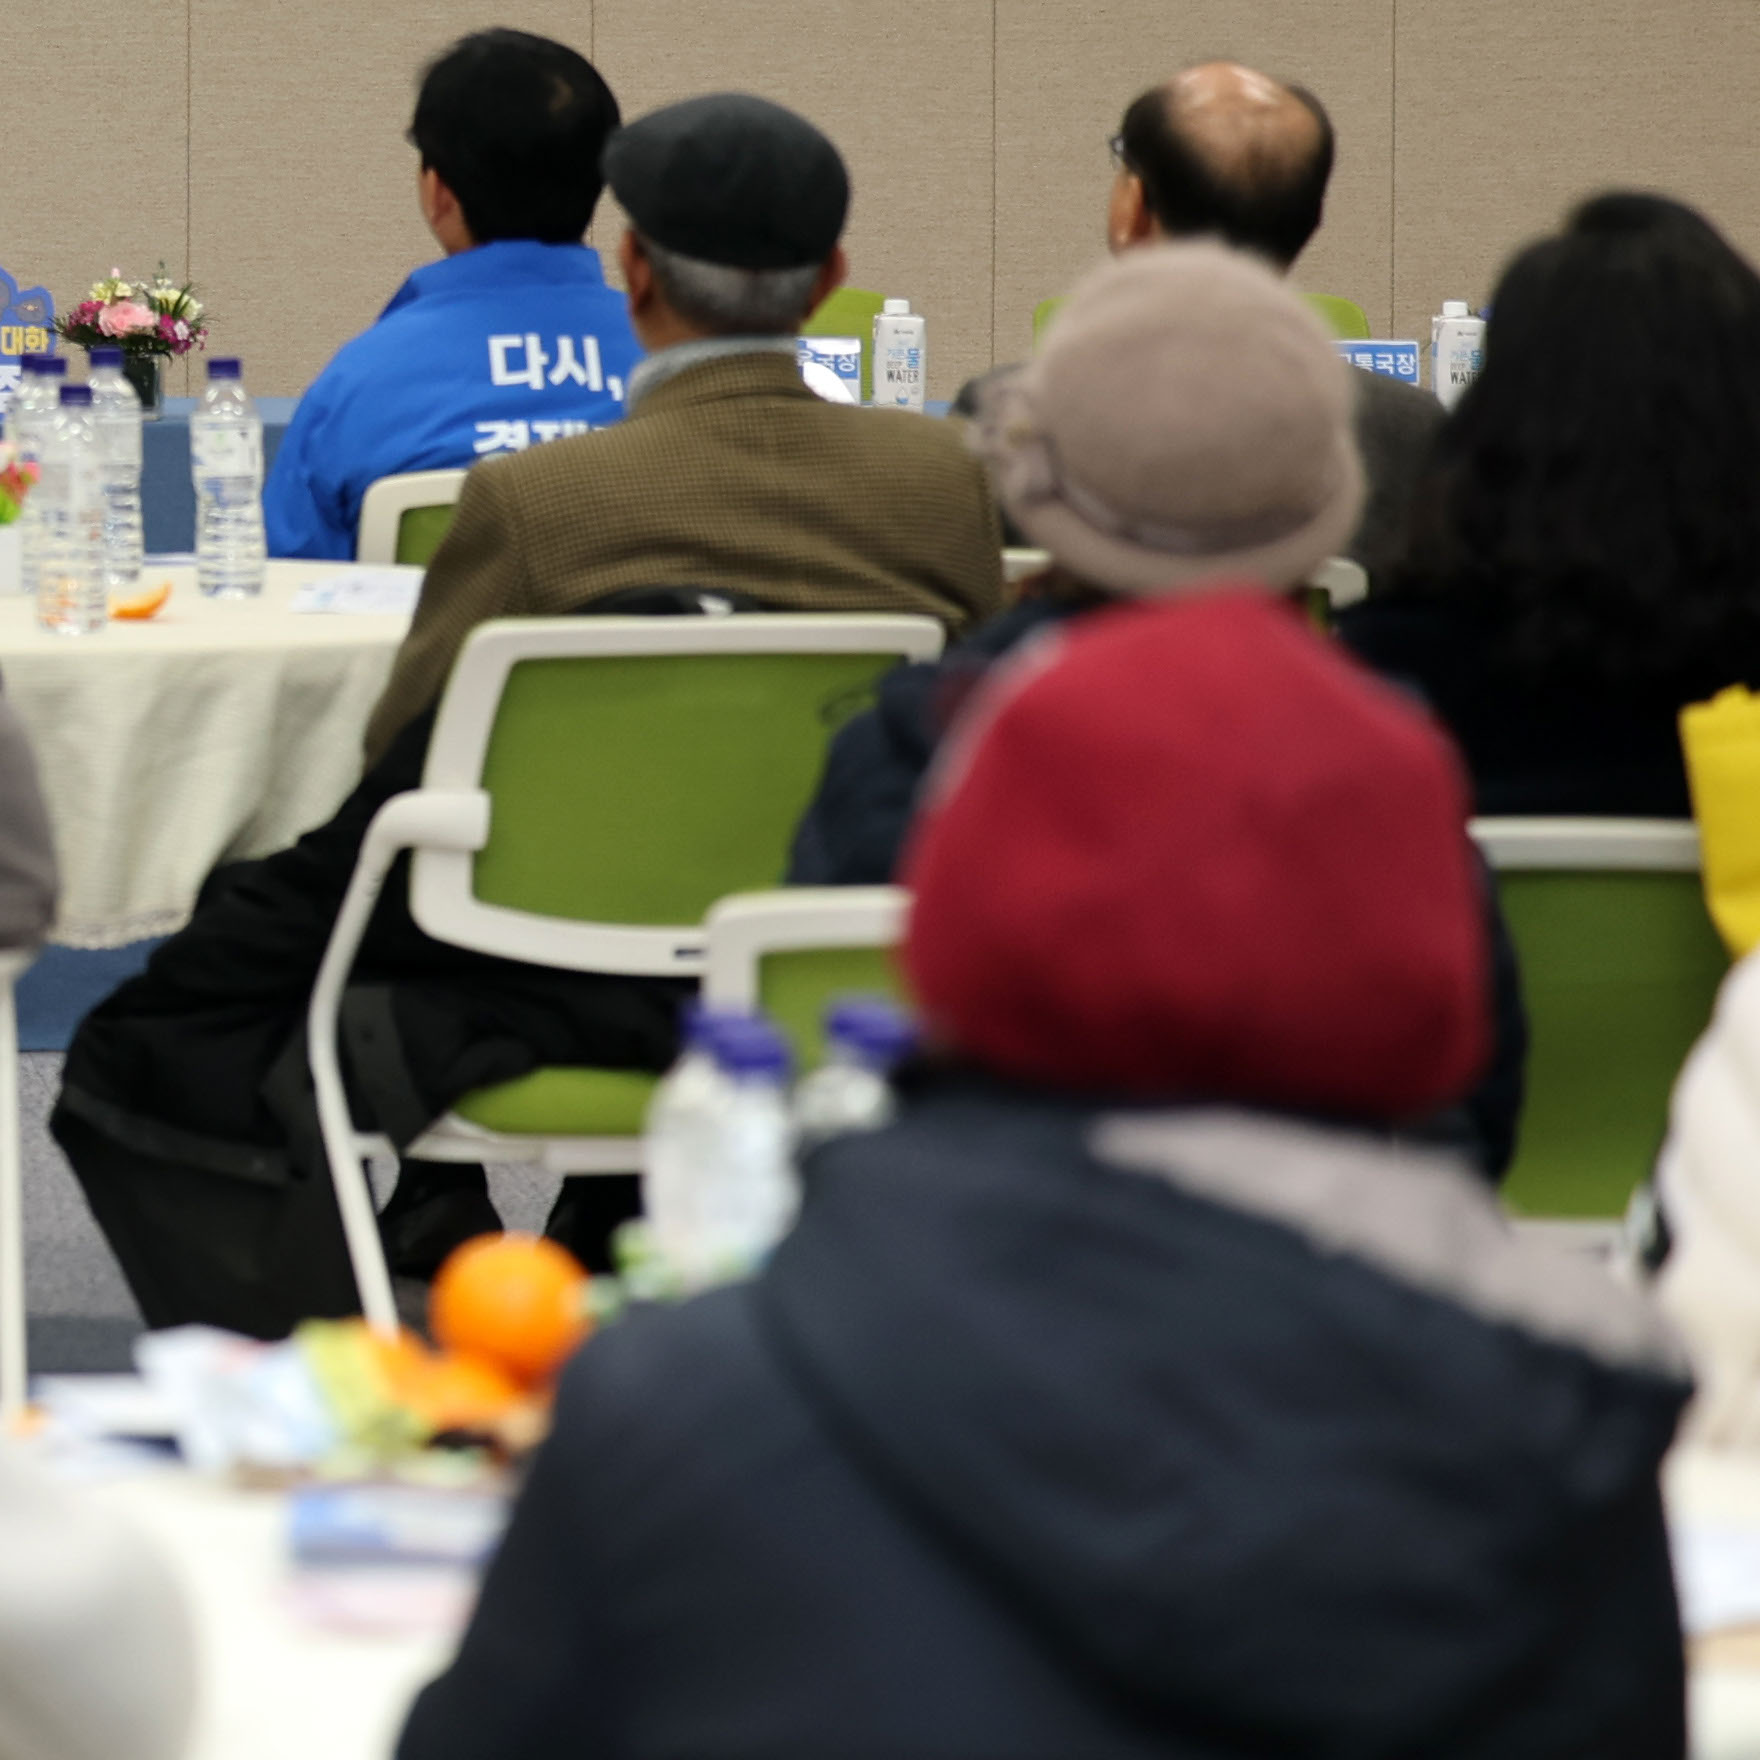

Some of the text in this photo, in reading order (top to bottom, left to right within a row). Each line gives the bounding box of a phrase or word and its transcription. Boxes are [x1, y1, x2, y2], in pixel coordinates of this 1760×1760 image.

[0, 325, 50, 356] 대화
[488, 332, 625, 402] 다시,
[886, 370, 920, 384] WATER
